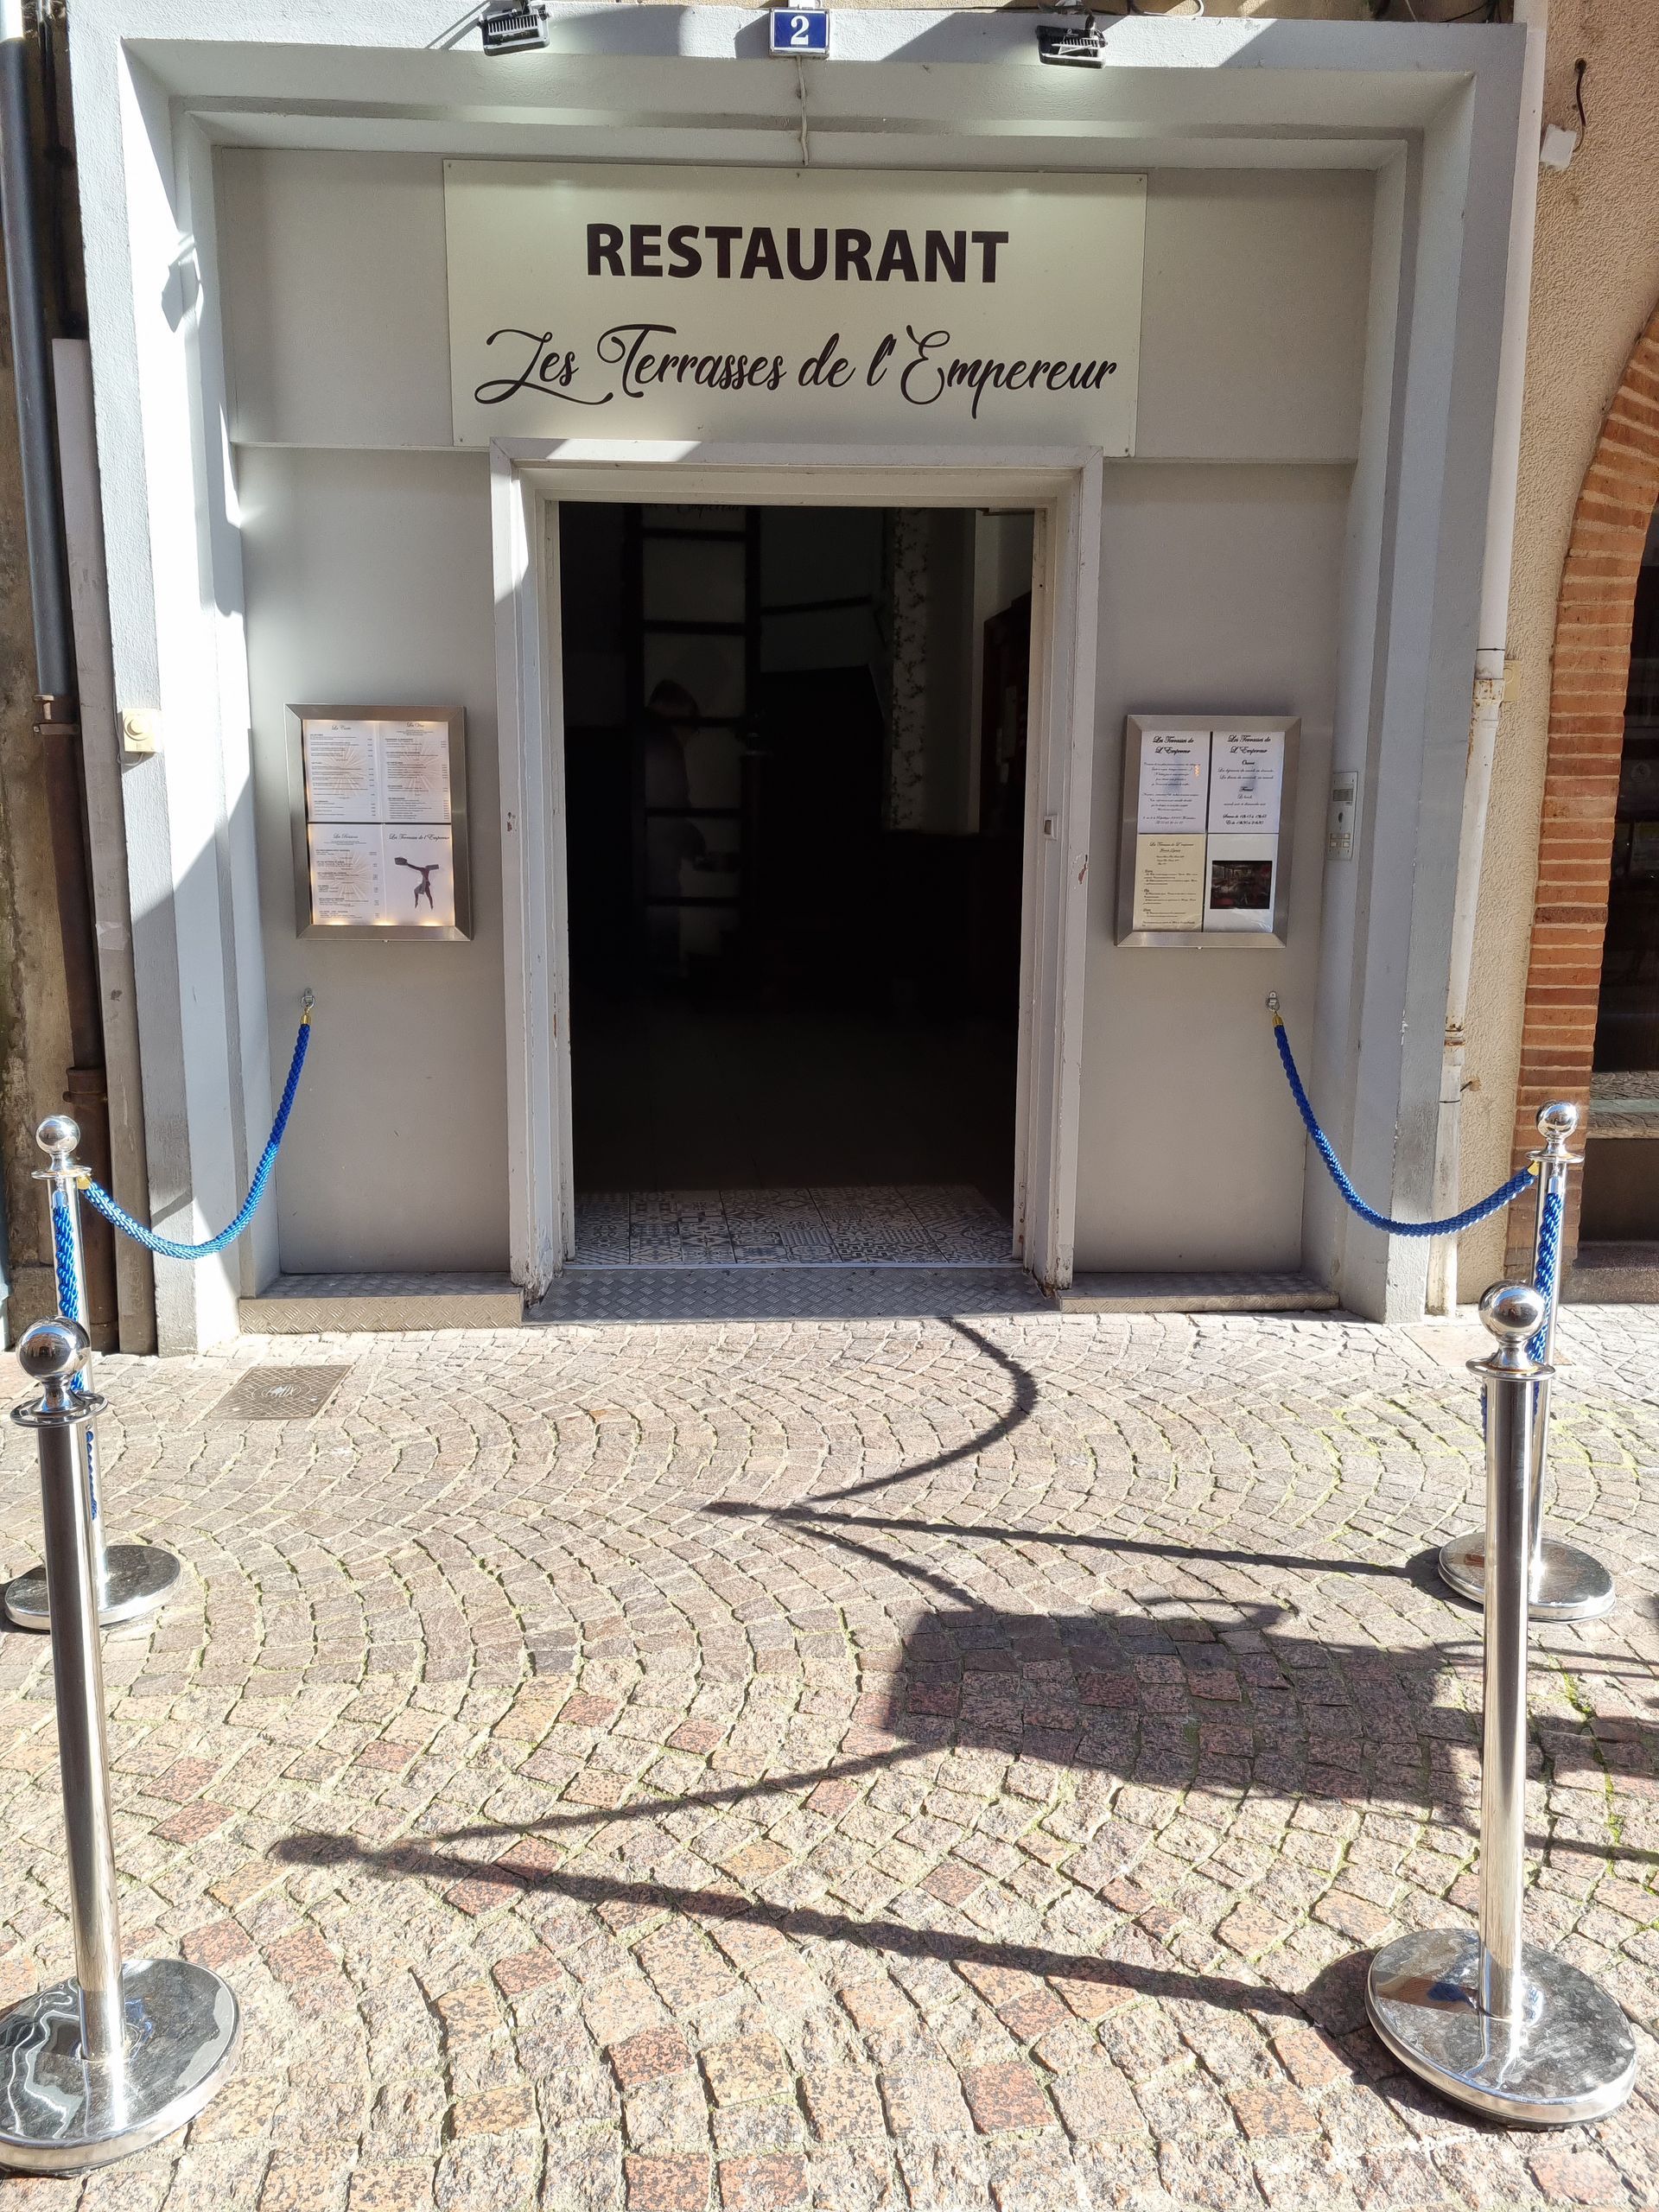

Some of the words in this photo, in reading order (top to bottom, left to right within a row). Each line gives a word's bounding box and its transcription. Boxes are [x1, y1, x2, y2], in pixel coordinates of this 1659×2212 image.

[790, 15, 810, 45] 2
[587, 223, 1009, 283] RESTAURANT
[474, 328, 613, 404] Les
[597, 323, 787, 398] Terrasses
[798, 333, 856, 387] de
[867, 325, 1117, 420] l'Empereur
